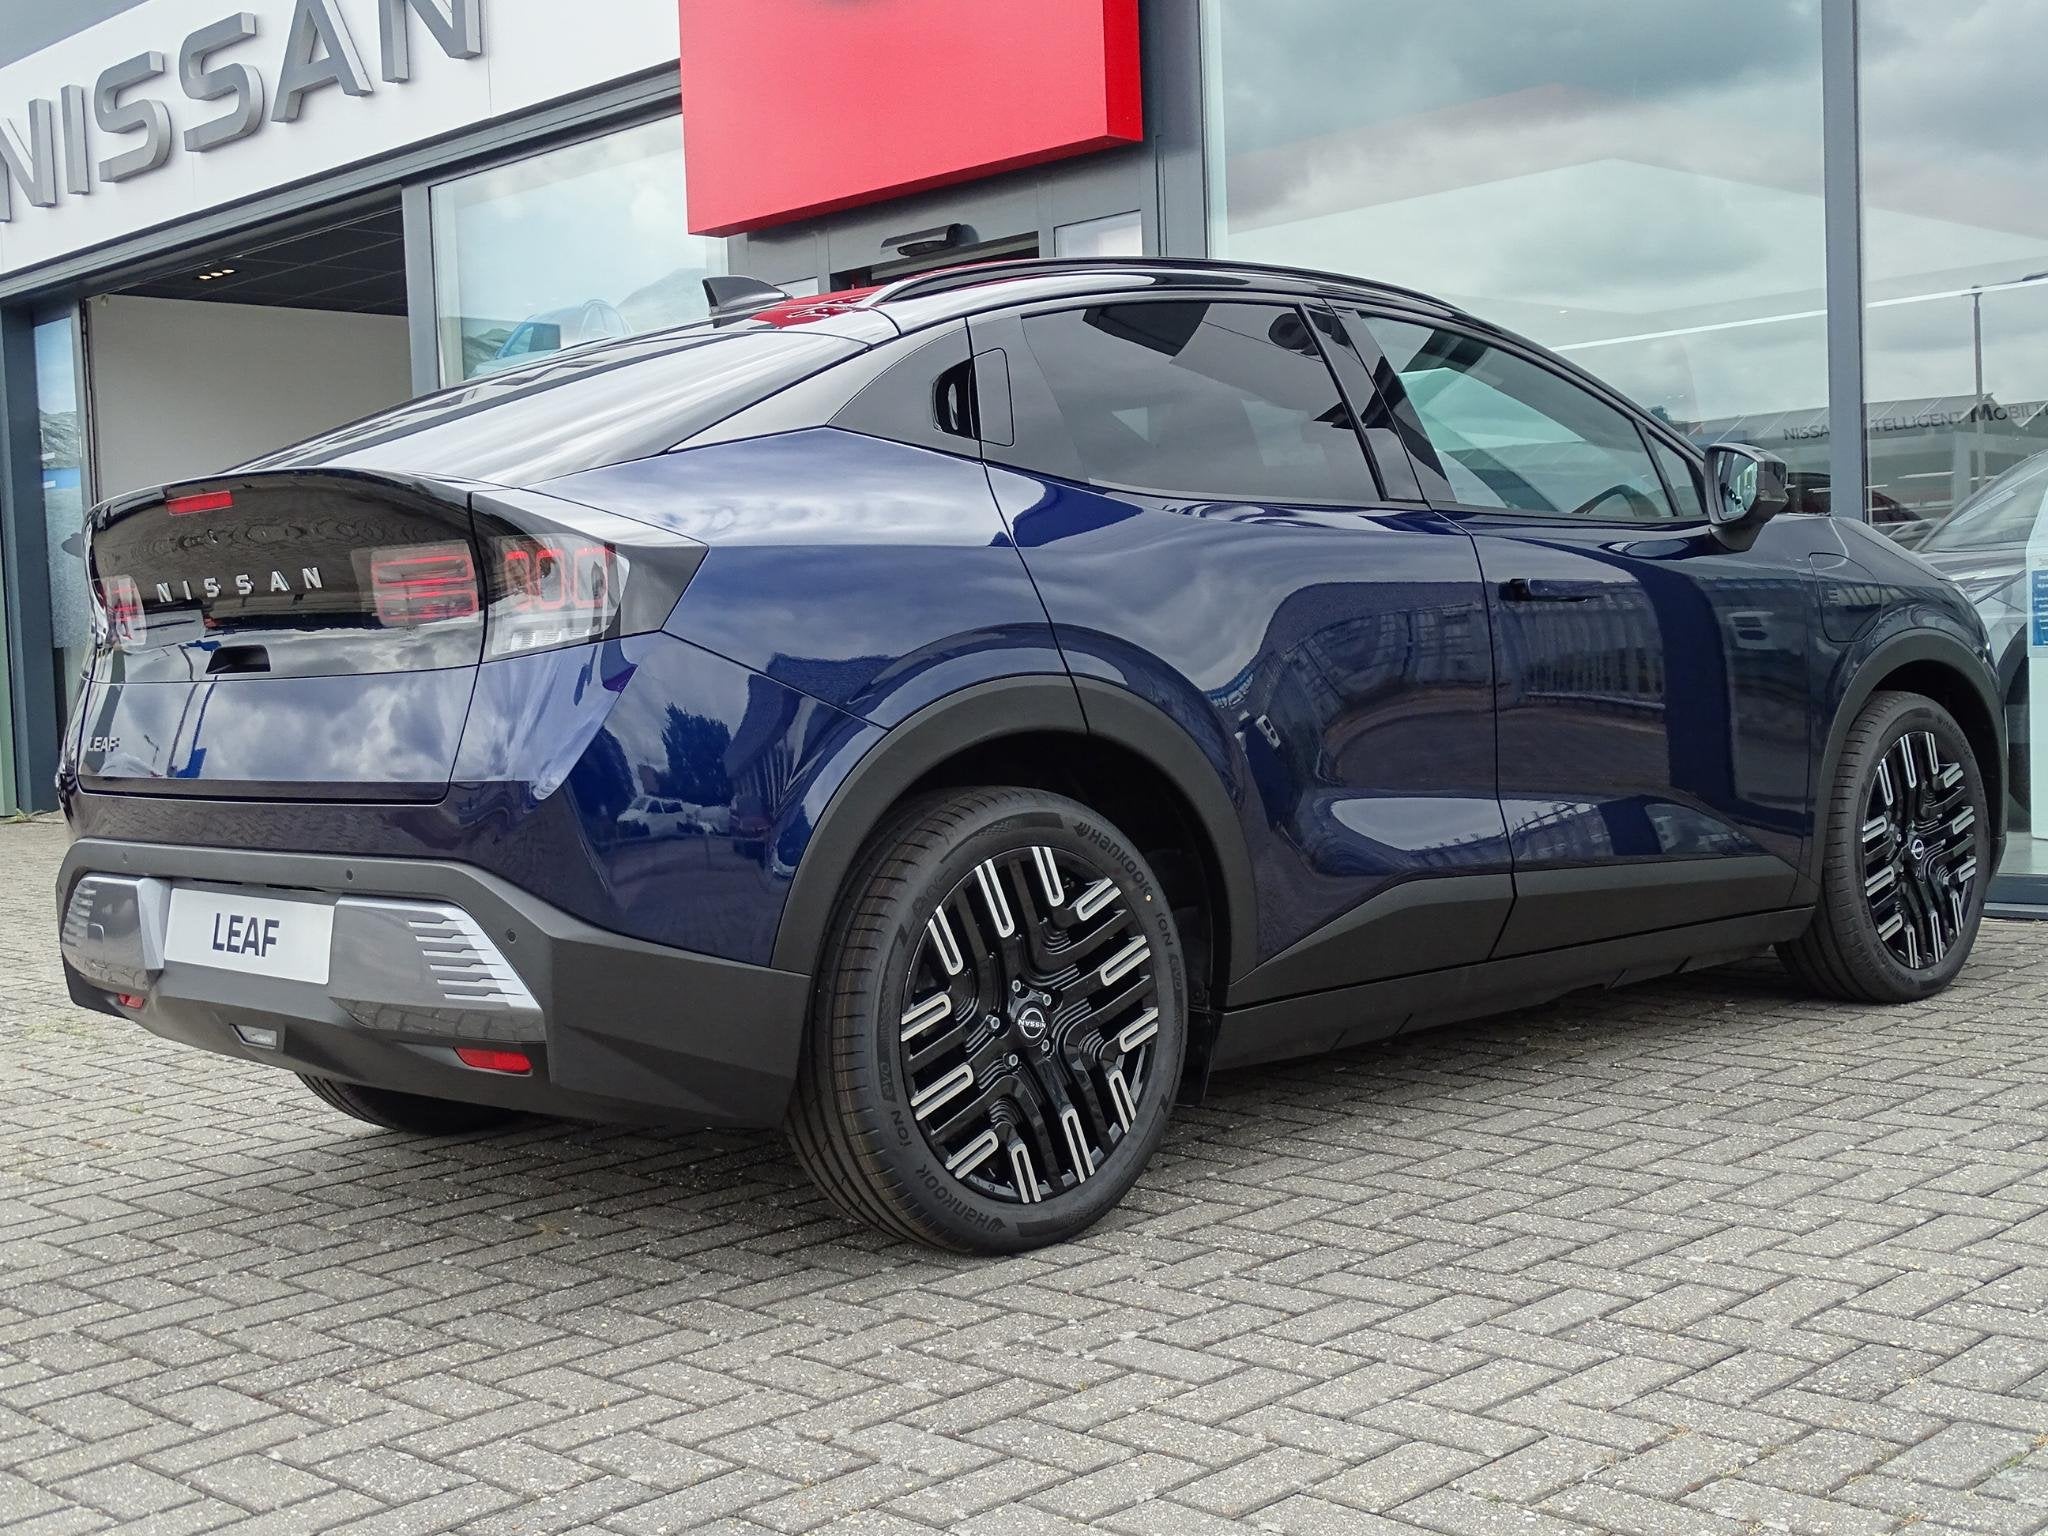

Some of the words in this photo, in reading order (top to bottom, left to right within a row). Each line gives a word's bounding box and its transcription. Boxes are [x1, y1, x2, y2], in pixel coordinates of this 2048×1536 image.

[1784, 423, 1831, 441] NISSA
[1869, 410, 1962, 433] TELLIGENT
[156, 567, 323, 603] NISSAN
[88, 736, 120, 752] LEAF
[212, 912, 280, 957] LEAF
[1018, 1019, 1046, 1028] NISSAN
